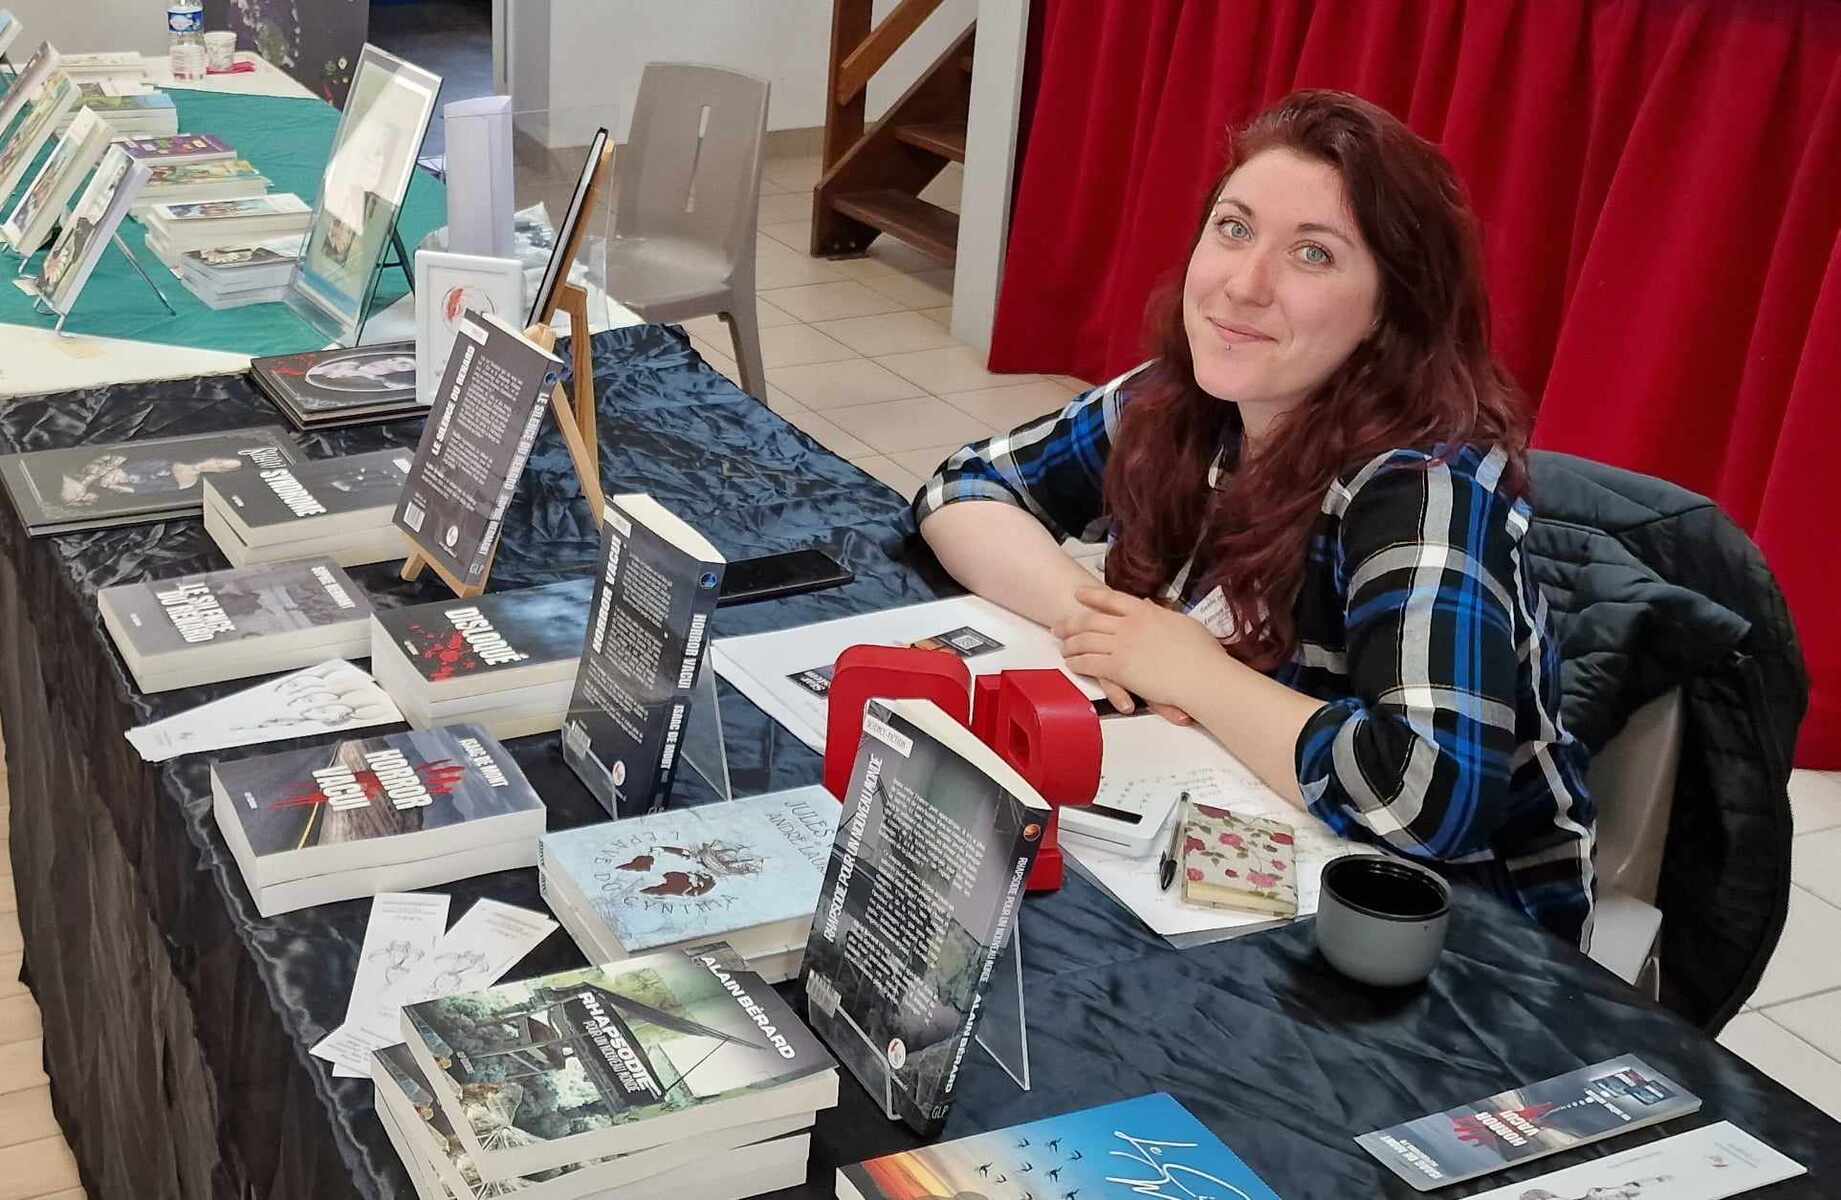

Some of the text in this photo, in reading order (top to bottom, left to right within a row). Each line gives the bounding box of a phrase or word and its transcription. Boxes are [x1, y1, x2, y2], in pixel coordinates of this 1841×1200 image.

[456, 345, 475, 386] RENARD
[450, 384, 461, 402] DU
[436, 399, 456, 442] SILENCE
[431, 440, 442, 456] LE
[260, 468, 327, 517] SYNDROME
[187, 594, 236, 633] SILENCE
[592, 584, 613, 655] HORROR
[605, 534, 622, 585] VACUI
[166, 604, 215, 643] RENARD
[445, 606, 530, 666] DISLOQUÉ
[684, 613, 707, 657] HORROR
[677, 656, 697, 690] VACUI
[312, 765, 371, 812] VACUI
[364, 748, 433, 811] HORROR
[783, 801, 835, 837] JULES
[838, 851, 855, 886] POUR
[851, 786, 873, 841] NOUVEAU
[864, 753, 883, 791] MONDE
[583, 1020, 603, 1038] POUR
[700, 955, 796, 1060] ALAIN BÉRARD
[577, 991, 662, 1100] RHAPSODIE
[945, 991, 982, 1094] ALAIN BÉRARD
[1475, 1111, 1528, 1147] HORROR
[1499, 1110, 1540, 1136] VACUI
